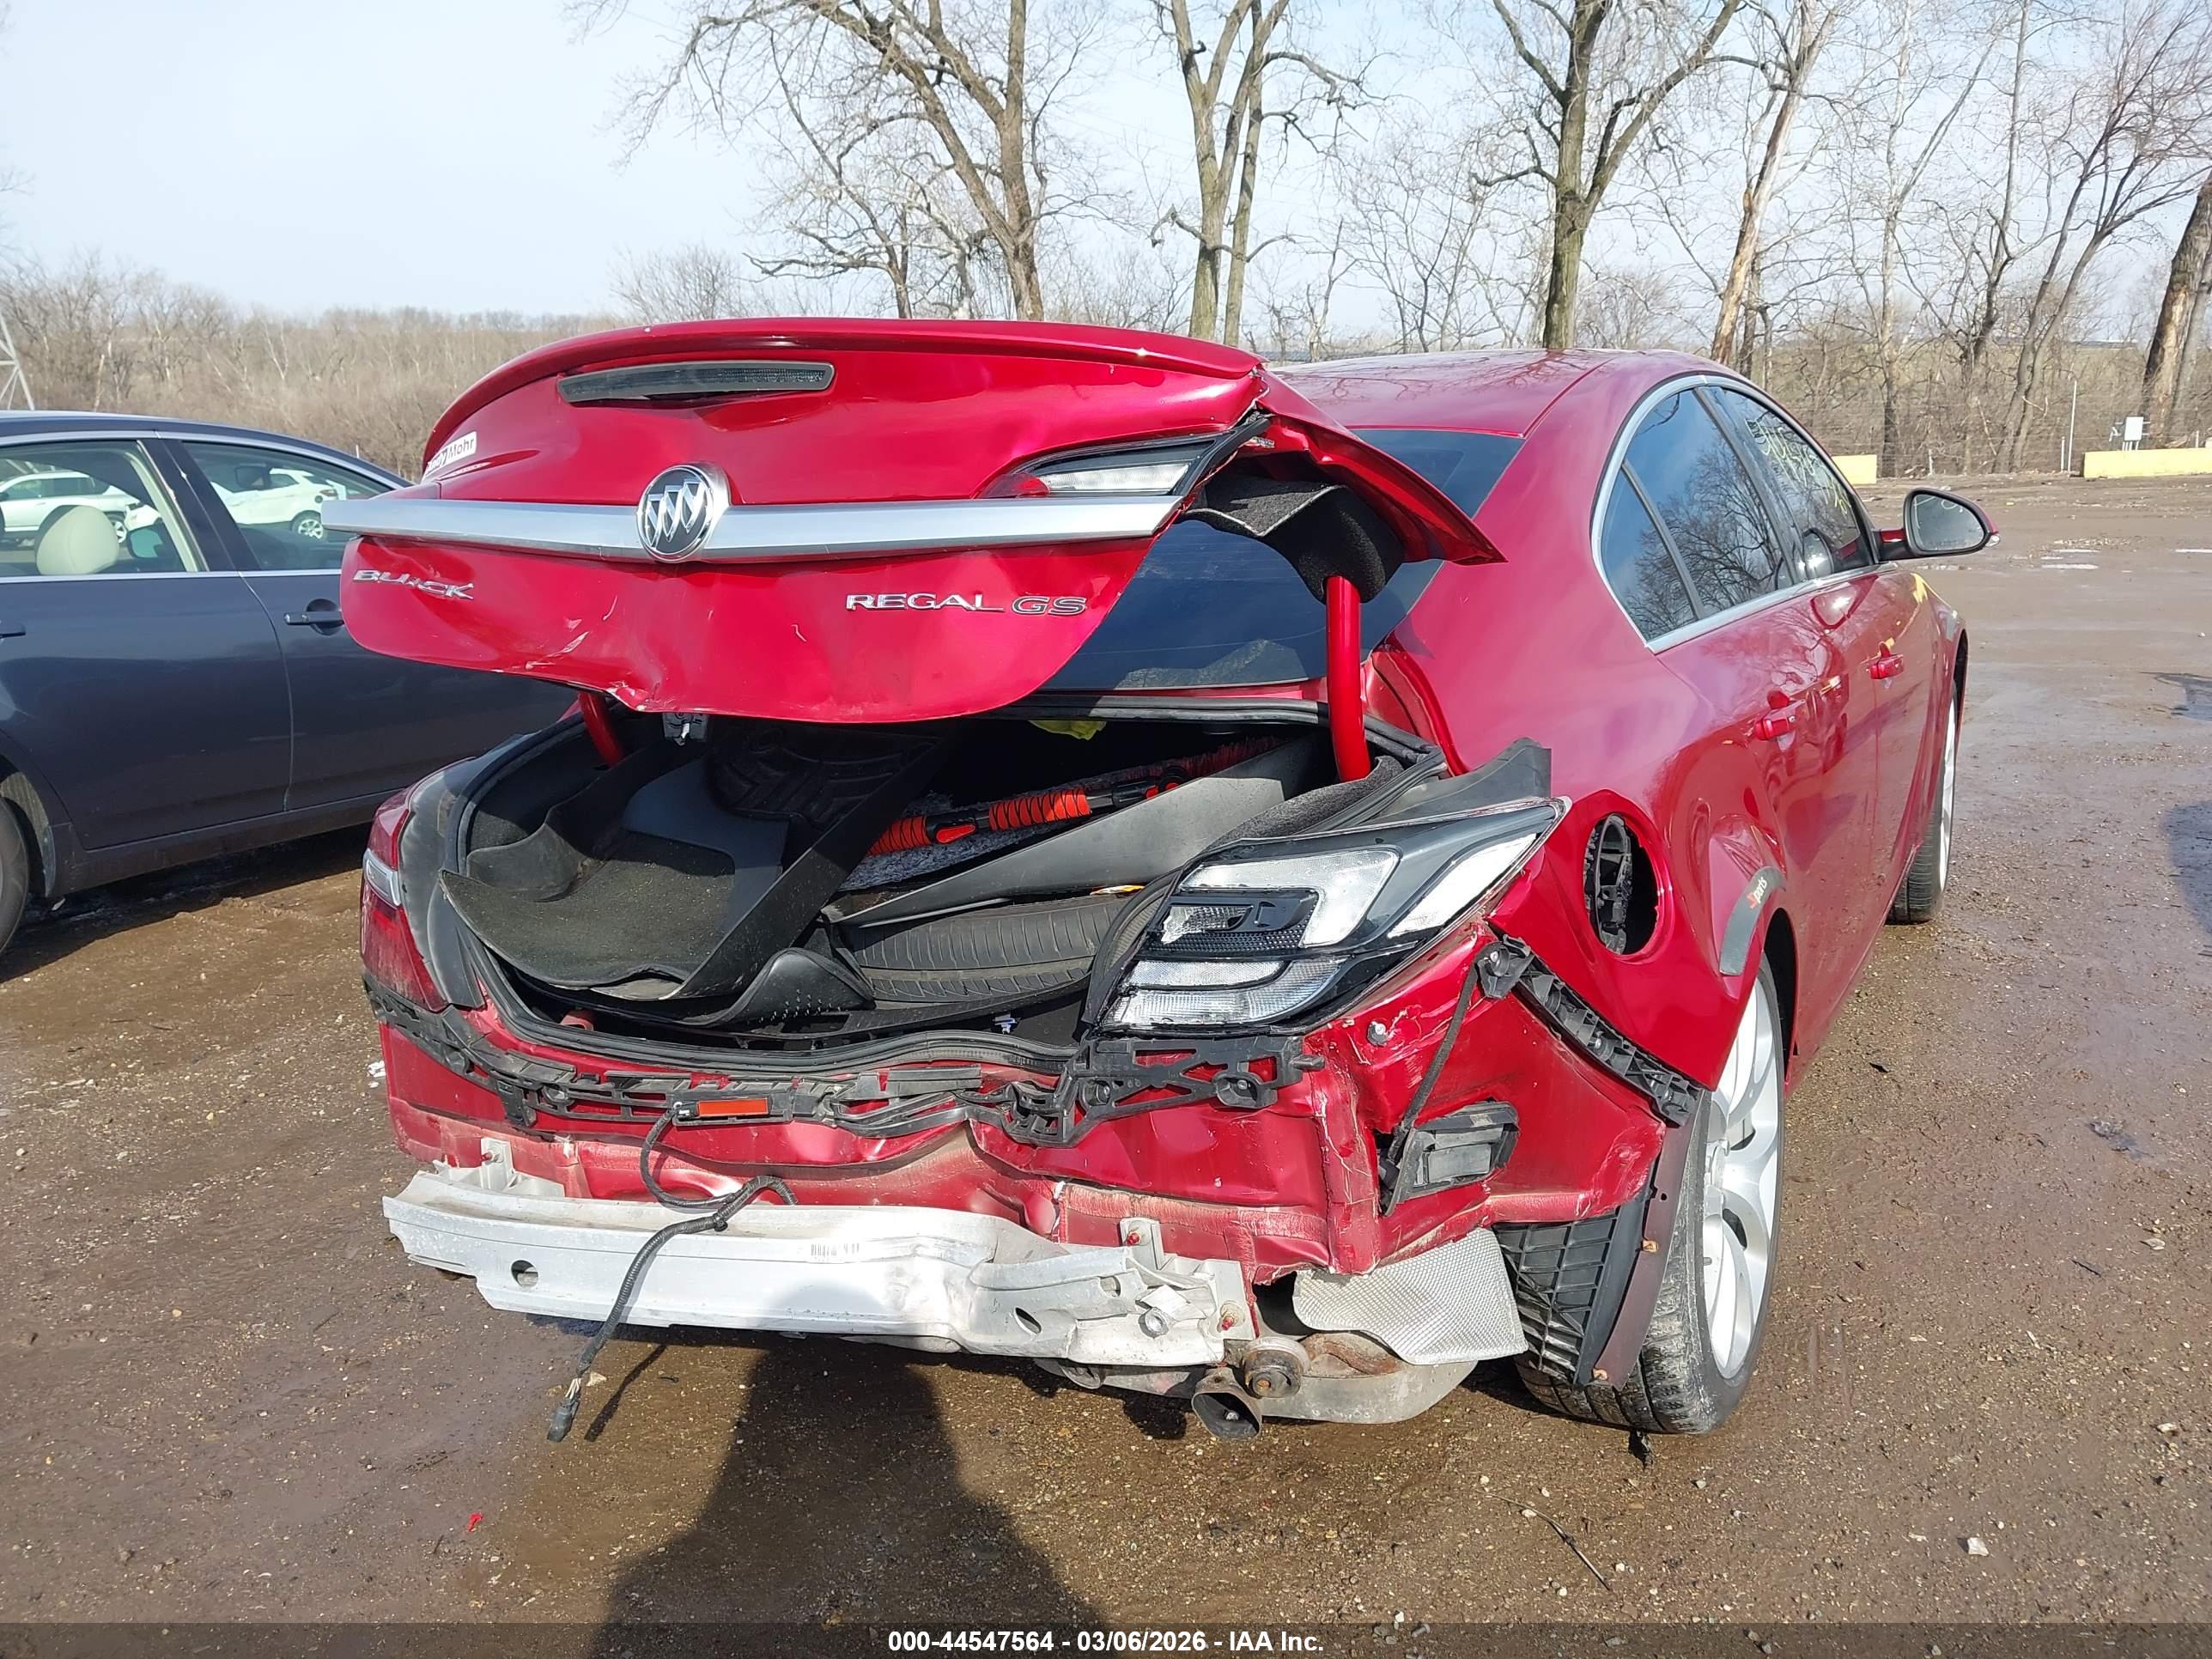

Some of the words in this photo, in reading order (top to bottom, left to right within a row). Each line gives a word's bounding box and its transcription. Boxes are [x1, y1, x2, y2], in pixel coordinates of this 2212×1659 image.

[448, 438, 474, 459] Mohr
[846, 592, 1005, 612] REGAL
[1011, 595, 1087, 616] GS
